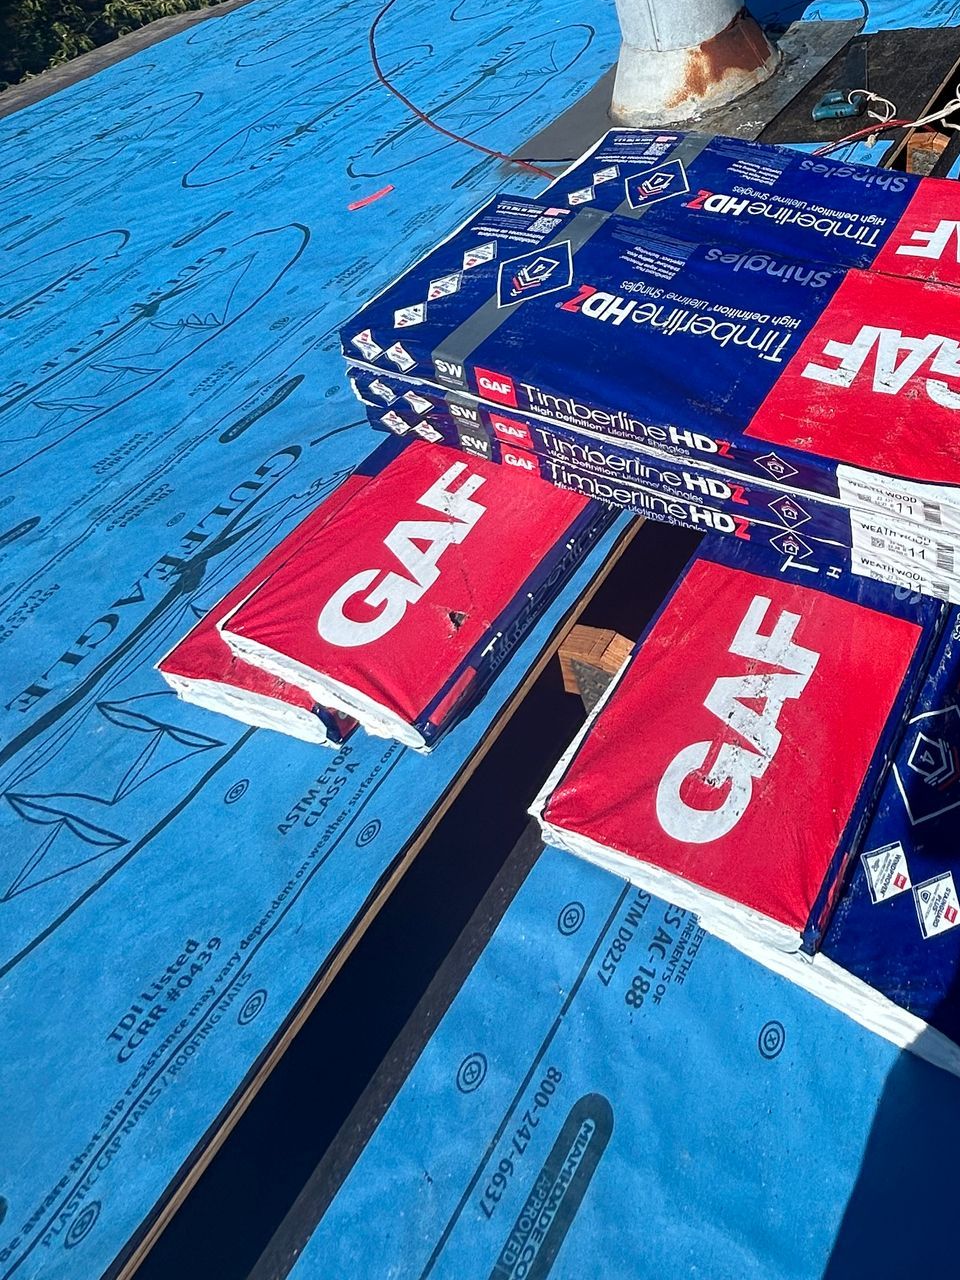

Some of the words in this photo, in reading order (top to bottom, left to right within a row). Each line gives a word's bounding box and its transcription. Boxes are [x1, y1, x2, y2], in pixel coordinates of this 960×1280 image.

[733, 185, 769, 202] Shingles
[799, 159, 909, 193] Shingles
[861, 213, 886, 226] High
[620, 280, 664, 298] Shingles
[704, 248, 833, 288] Shingles
[771, 311, 801, 330] High
[434, 358, 462, 378] SW
[478, 376, 512, 396] GAF
[450, 404, 478, 422] SW
[494, 422, 528, 439] GAF
[520, 382, 735, 459] TimberlineHDZ
[530, 404, 553, 417] High
[647, 438, 690, 456] Shingles
[461, 434, 489, 453] SW
[504, 453, 537, 471] GAF
[537, 428, 749, 506] TimberlineHDZ
[546, 460, 751, 541] TimberlineHDZ
[896, 502, 914, 516] 11
[5, 445, 303, 713] GULFEAGLE
[318, 461, 488, 648] GAF
[909, 547, 927, 561] 11
[654, 593, 821, 844] GAF
[277, 788, 321, 836] ASTM
[303, 776, 348, 828] CLASS
[345, 761, 361, 774] A
[107, 1004, 145, 1043] TDI
[140, 938, 201, 1003] Listed
[625, 925, 674, 1010] AC-188
[21, 1175, 71, 1235] aware
[69, 1135, 102, 1173] that
[100, 1099, 126, 1131] slip
[124, 1018, 189, 1097] resistance
[188, 984, 217, 1018] may
[215, 951, 242, 985] vary
[239, 879, 298, 951] dependent
[296, 861, 310, 880] on
[307, 807, 352, 861] weather,
[348, 763, 382, 807] surface
[116, 1003, 168, 1064] CCRR
[166, 935, 222, 1003] #0439
[41, 1170, 101, 1249] PLASTIC
[96, 1135, 123, 1172] CAP
[122, 1086, 163, 1136] NAILS
[168, 1011, 223, 1078] ROOFING
[221, 972, 254, 1013] NAILS
[479, 1066, 563, 1219] 800-247-6637
[503, 1173, 553, 1266] APPROVED
